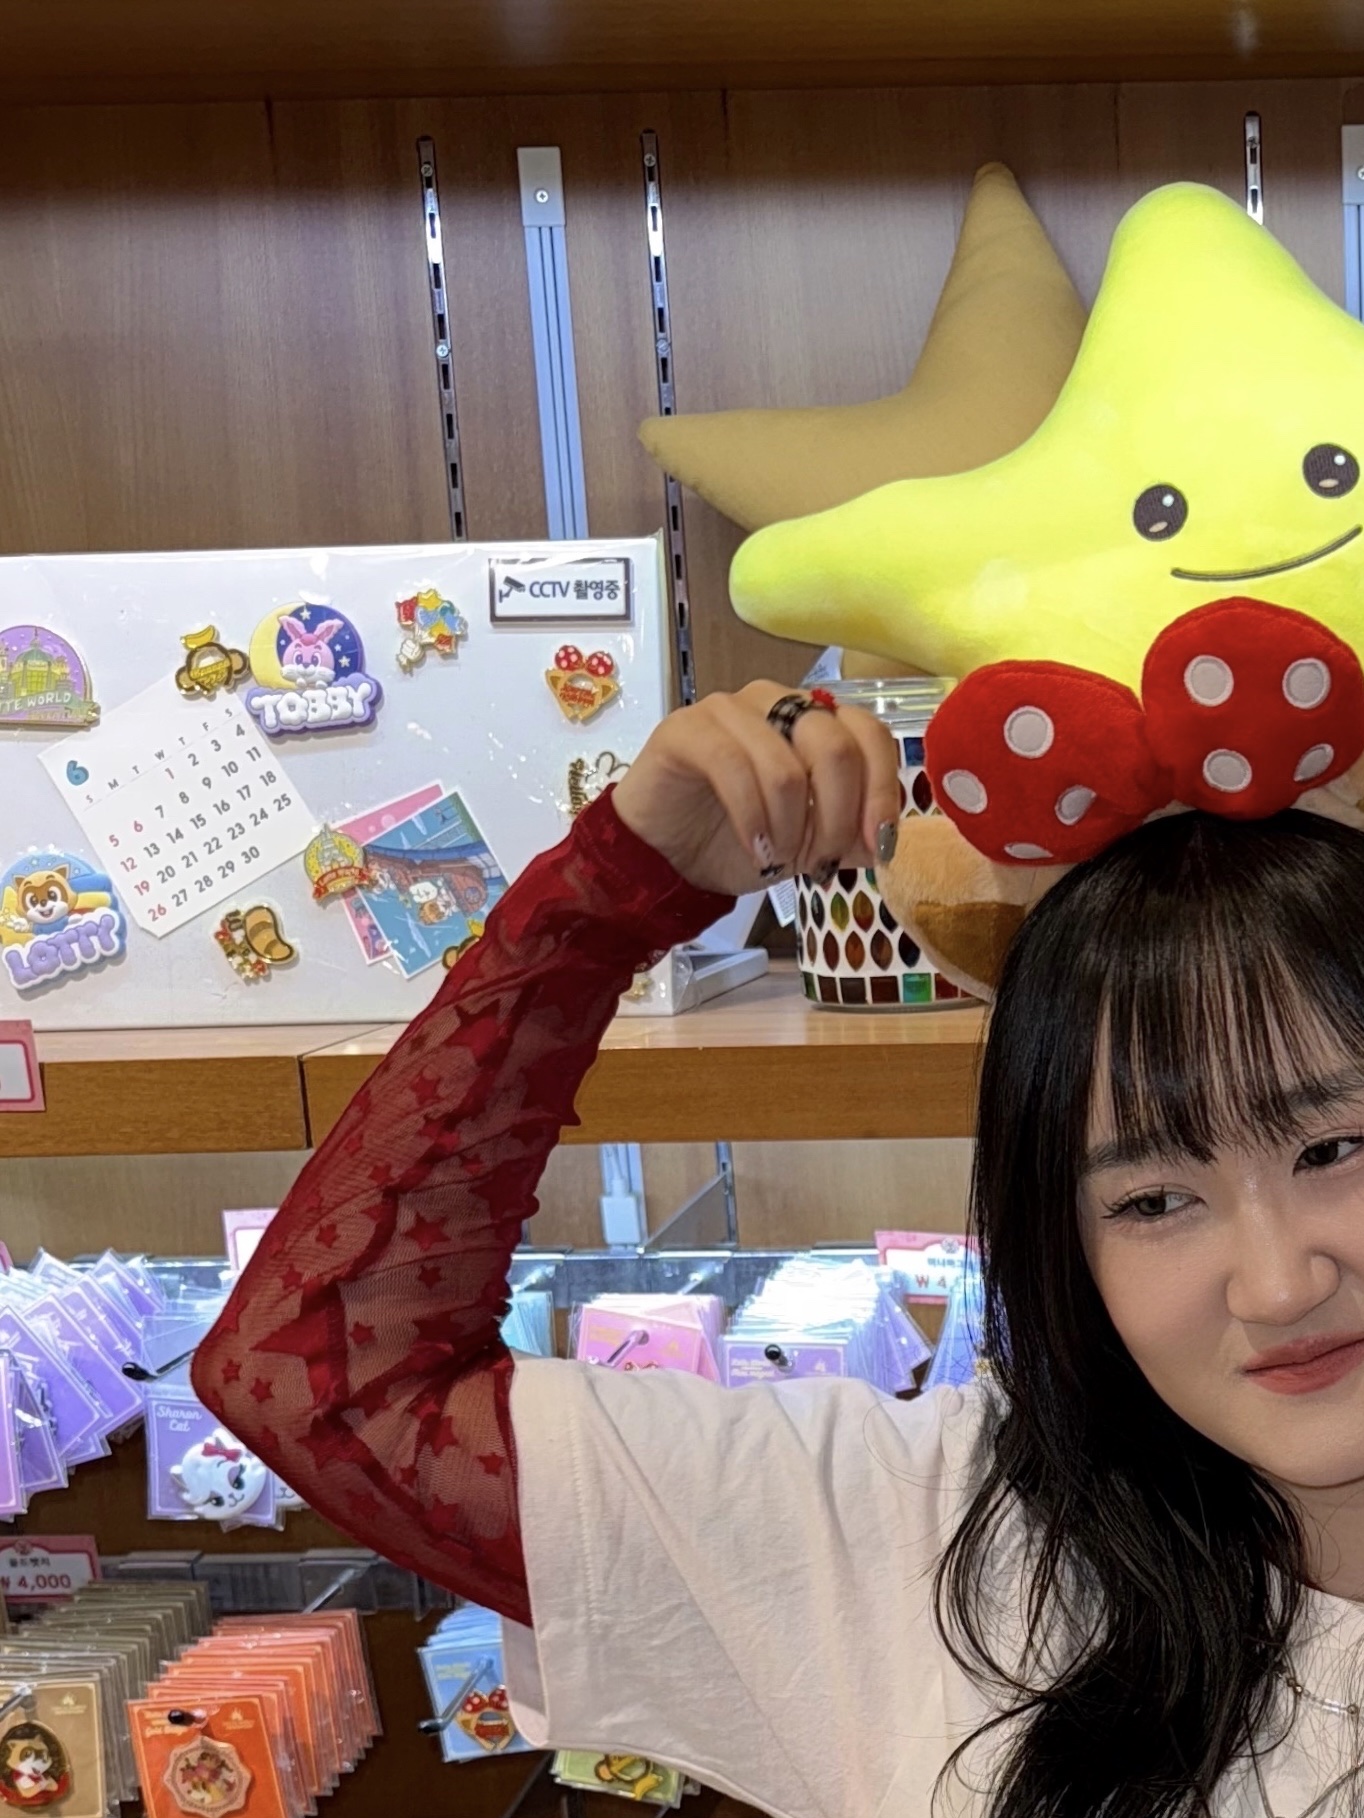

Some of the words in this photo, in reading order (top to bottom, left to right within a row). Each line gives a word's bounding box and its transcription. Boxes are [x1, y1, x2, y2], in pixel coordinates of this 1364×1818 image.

[529, 580, 570, 598] CCTV
[573, 579, 620, 600] 촬영중
[28, 692, 72, 707] WORLD
[250, 682, 373, 728] TOBBY
[66, 760, 89, 786] 6
[108, 779, 119, 790] M
[132, 765, 140, 775] T
[154, 750, 166, 760] W
[178, 737, 186, 746] T
[202, 722, 209, 732] F
[225, 708, 233, 718] S
[164, 768, 175, 780] 1
[188, 754, 199, 766] 2
[211, 739, 222, 752] 3
[235, 724, 245, 736] 4
[109, 834, 120, 847] 5
[133, 820, 143, 832] 6
[154, 805, 165, 819] 7
[179, 791, 189, 804] 8
[202, 776, 212, 789] 9
[221, 761, 239, 777] 10
[246, 746, 262, 762] 11
[120, 857, 138, 873] 12
[143, 842, 160, 858] 13
[166, 827, 184, 844] 14
[190, 814, 207, 830] 15
[213, 799, 230, 815] 16
[236, 785, 252, 801] 17
[259, 770, 277, 787] 18
[134, 880, 151, 896] 19
[156, 865, 176, 883] 20
[181, 851, 198, 868] 21
[203, 836, 222, 855] 22
[227, 822, 246, 841] 23
[249, 808, 268, 826] 24
[273, 793, 292, 812] 25
[148, 904, 167, 922] 26
[171, 889, 188, 907] 27
[194, 875, 213, 893] 28
[217, 860, 235, 879] 29
[240, 846, 260, 864] 30
[5, 914, 116, 981] LOTTY
[156, 1405, 203, 1420] Sharon
[18, 1574, 71, 1591] 4,000
